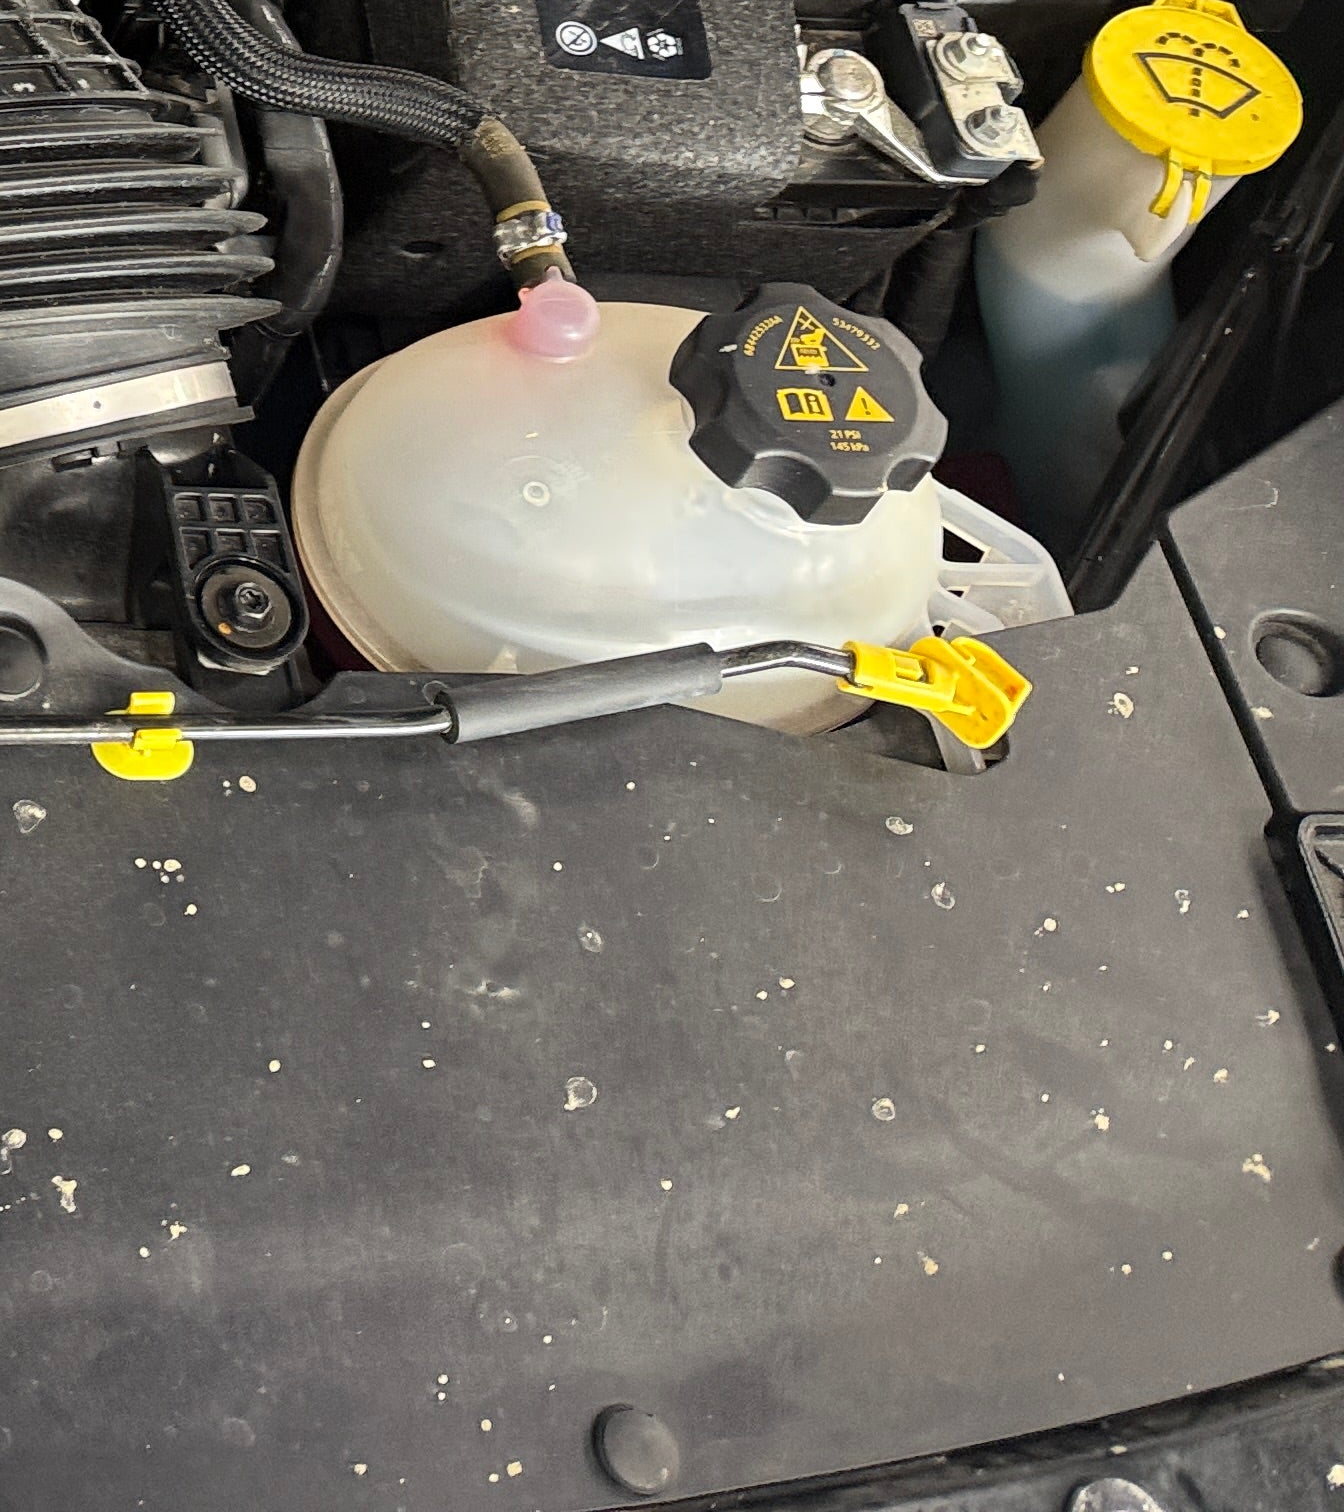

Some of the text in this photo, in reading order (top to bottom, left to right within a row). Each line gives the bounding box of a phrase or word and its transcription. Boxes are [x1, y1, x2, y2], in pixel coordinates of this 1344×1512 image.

[829, 430, 861, 439] 21 PSI
[830, 442, 869, 452] 145 kPa
